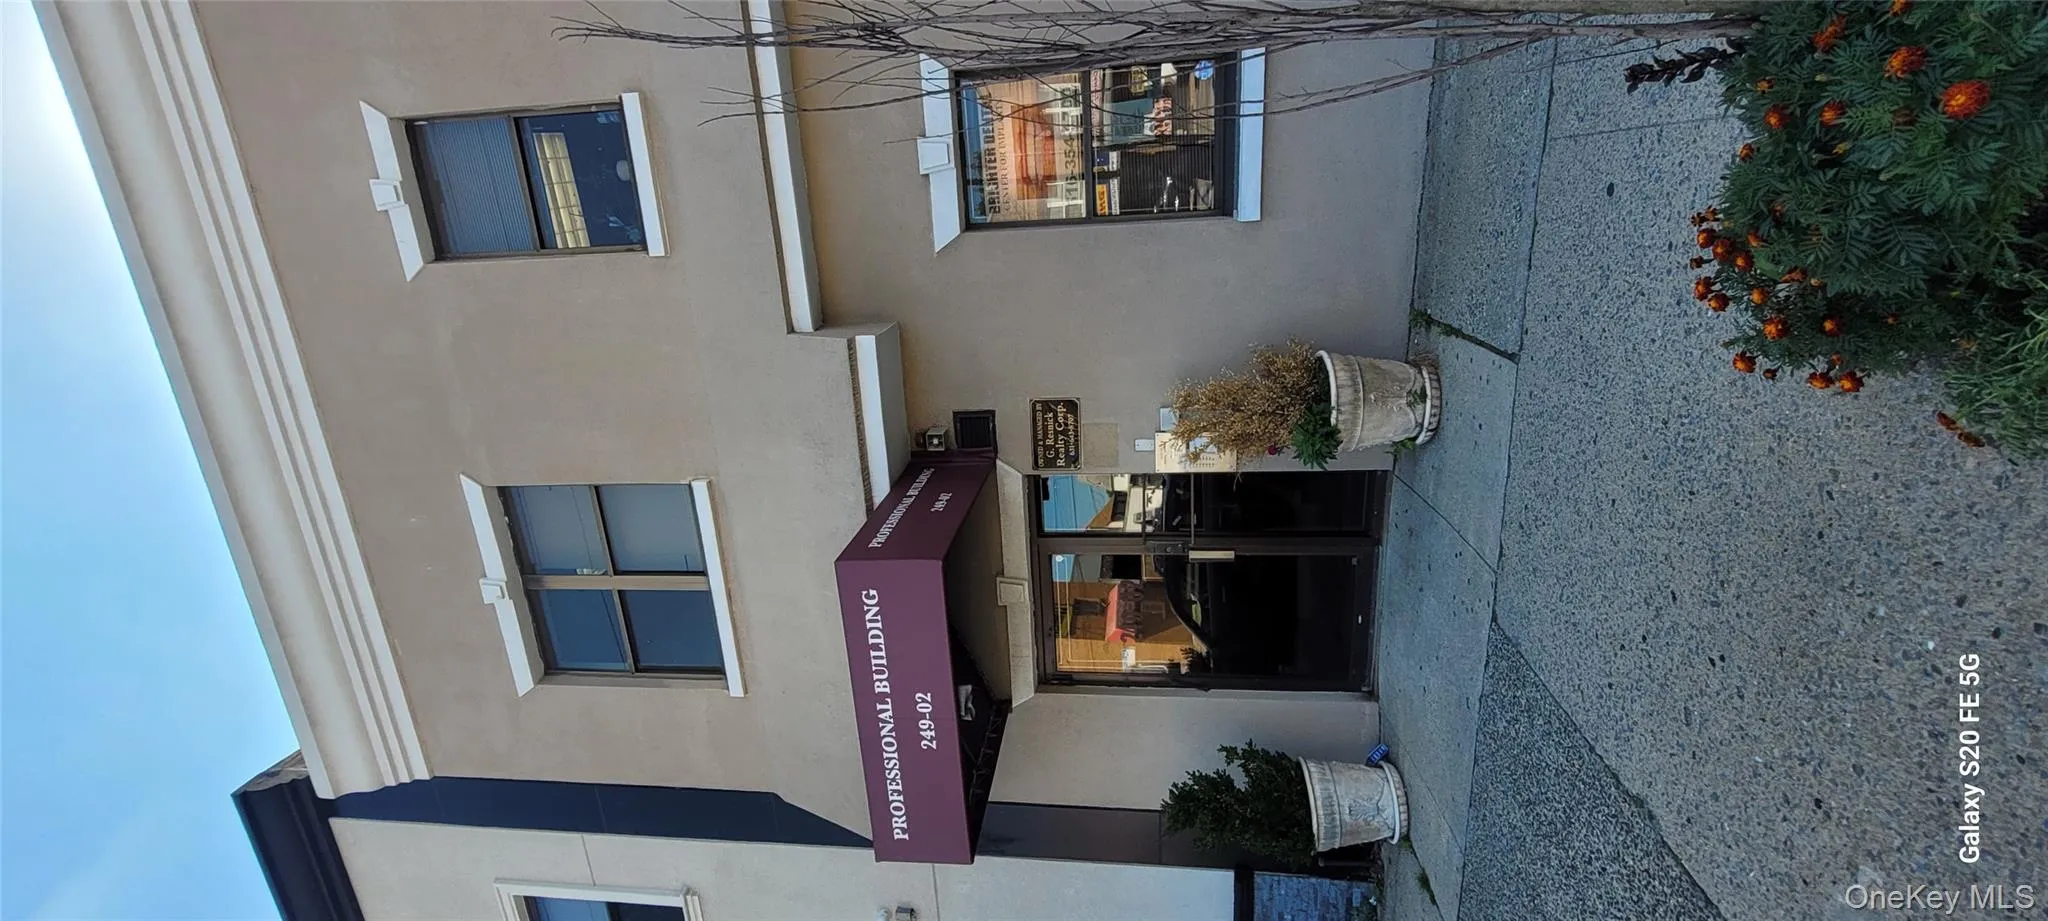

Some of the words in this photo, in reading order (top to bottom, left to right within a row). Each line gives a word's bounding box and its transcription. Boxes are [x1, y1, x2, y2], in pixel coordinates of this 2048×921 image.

[999, 152, 1008, 171] FOR
[1044, 412, 1054, 445] Resnick
[1055, 402, 1066, 431] Corp.
[1046, 448, 1055, 458] G.
[1055, 435, 1067, 467] Realty
[868, 496, 916, 548] PROFESSIONAL
[906, 468, 935, 496] BUILDING
[930, 492, 953, 512] 249-02
[861, 588, 890, 694] BUILDING
[915, 693, 937, 750] 249-02
[876, 698, 909, 840] PROFESSIONAL
